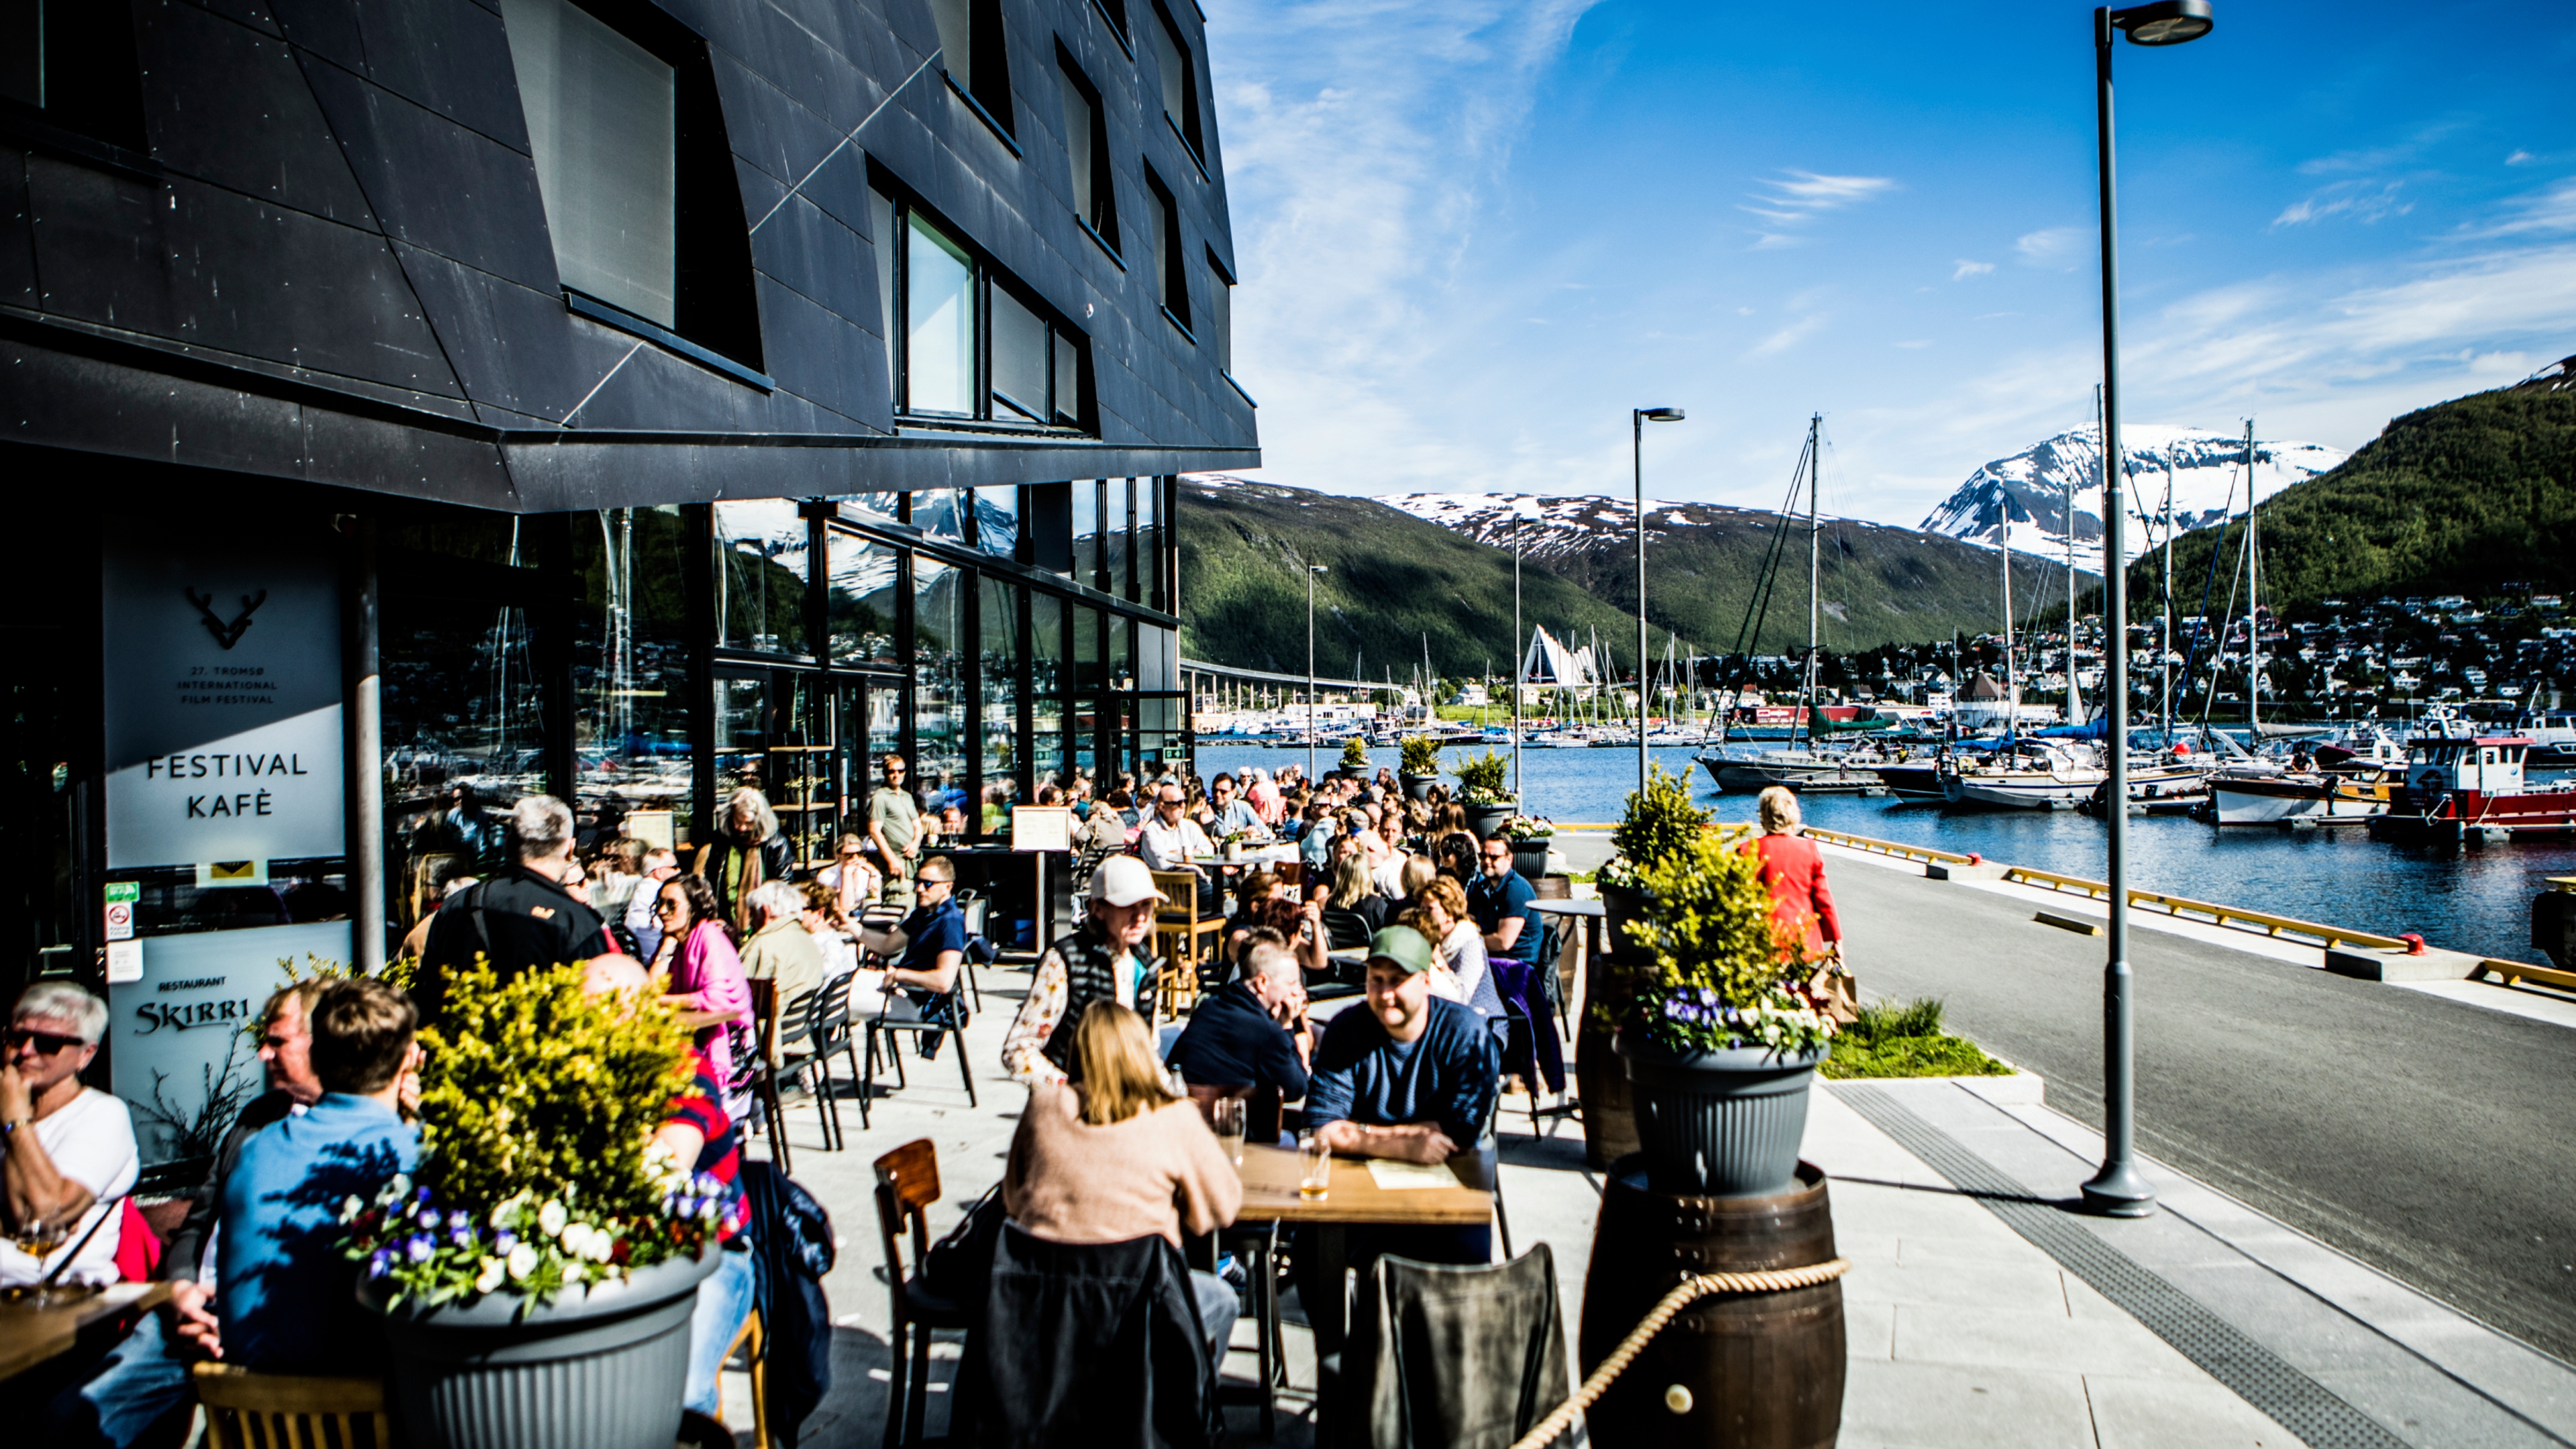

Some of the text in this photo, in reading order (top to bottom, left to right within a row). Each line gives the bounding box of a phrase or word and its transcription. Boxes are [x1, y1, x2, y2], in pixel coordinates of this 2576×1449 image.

[191, 666, 265, 676] 27. TROMSØ
[177, 680, 278, 690] INTERNATIONAL
[182, 695, 274, 704] FILM FESTIVAL
[147, 753, 308, 780] FESTIVAL
[158, 976, 227, 992] RESTAURANT
